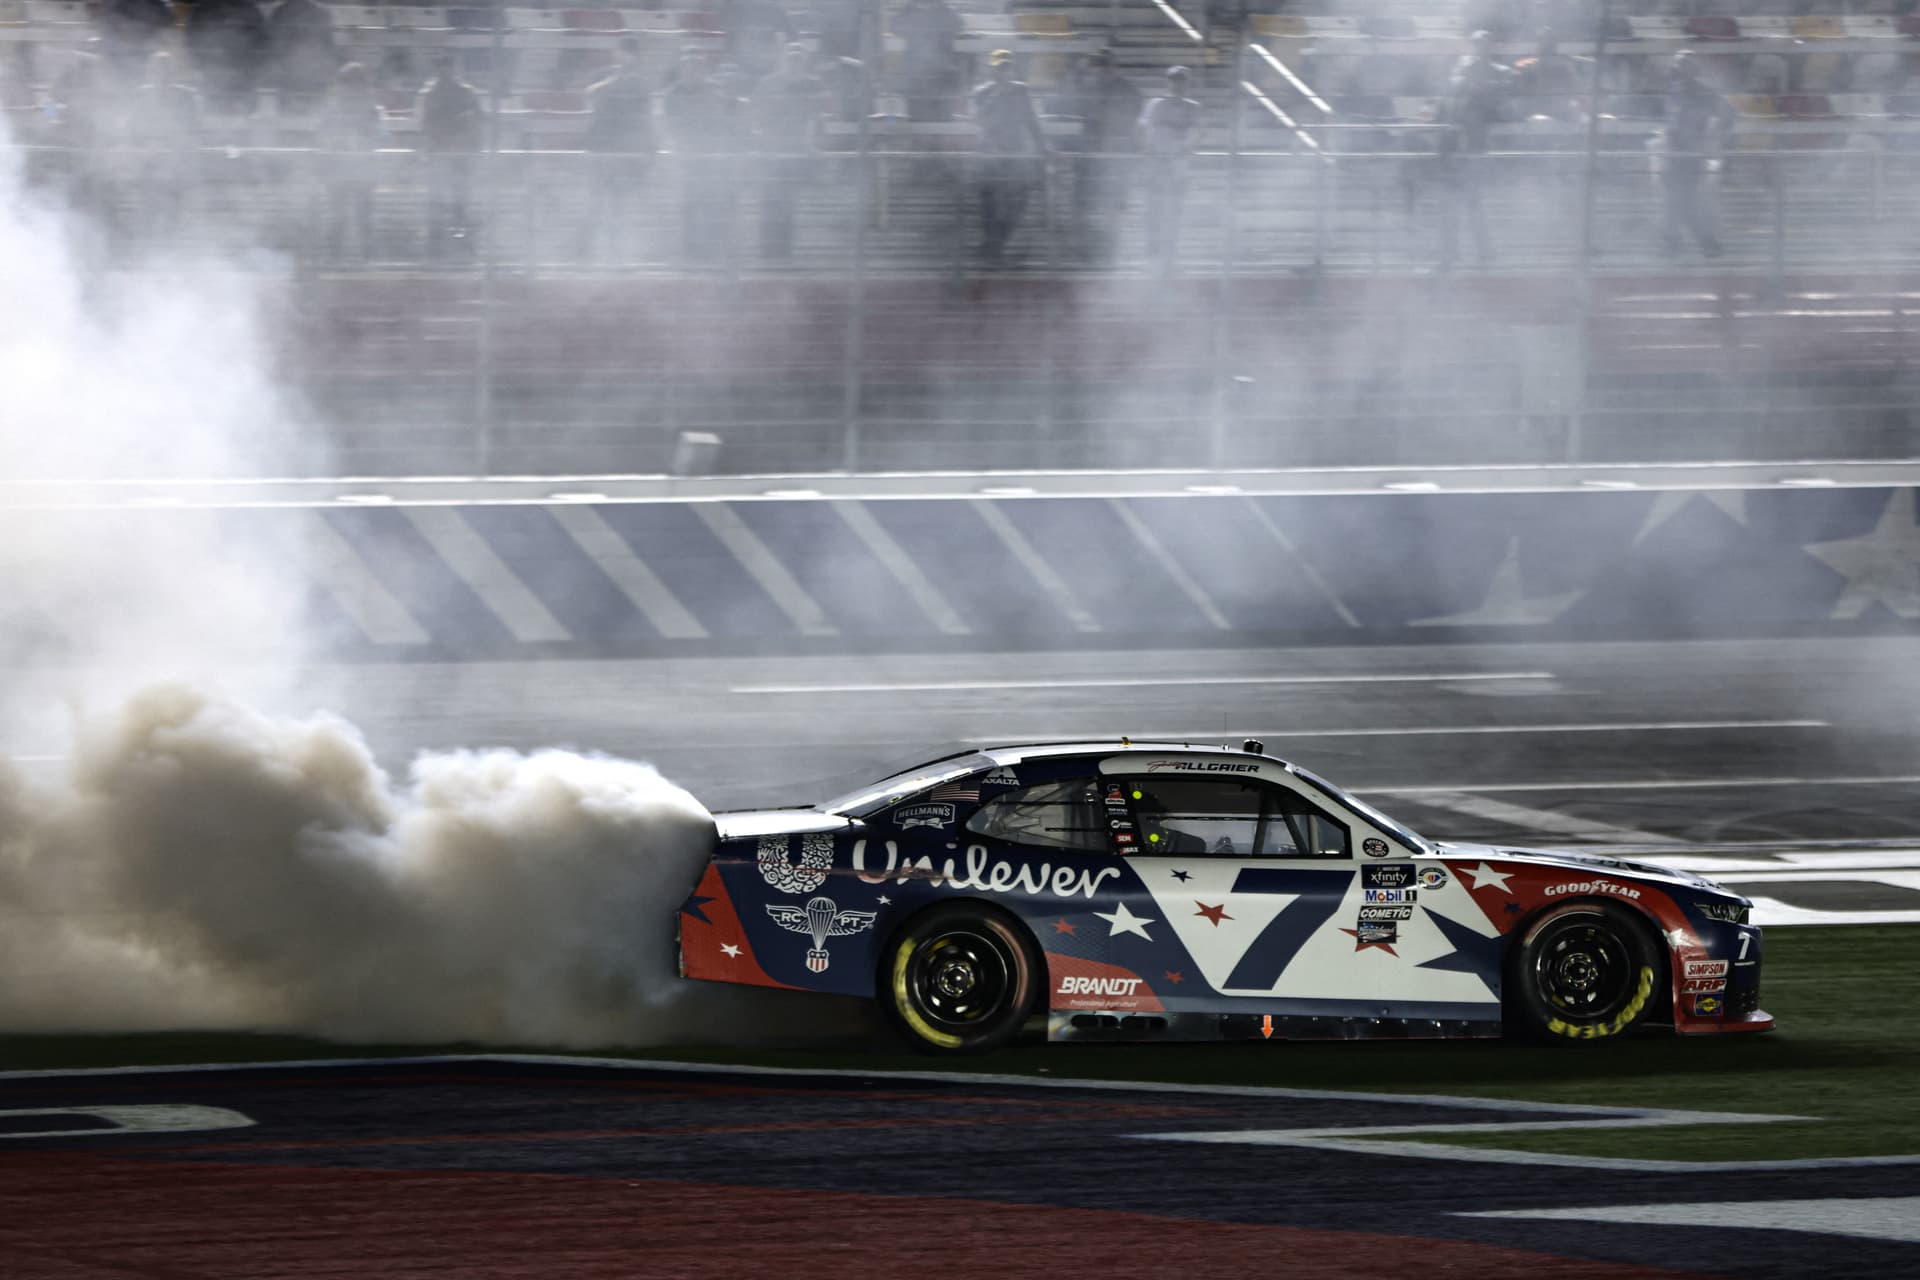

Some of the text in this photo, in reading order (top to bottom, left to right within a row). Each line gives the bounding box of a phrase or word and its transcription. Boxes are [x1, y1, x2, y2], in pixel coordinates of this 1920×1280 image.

[982, 778, 1020, 786] AXALTA
[852, 840, 1121, 899] Unilever
[1370, 871, 1408, 885] xfinity
[1365, 890, 1402, 903] Mobil
[781, 912, 860, 928] RC PT
[1222, 868, 1357, 990] 7
[1737, 931, 1751, 960] 7
[1688, 963, 1726, 976] SIMPSON
[1057, 976, 1143, 996] BRANDT
